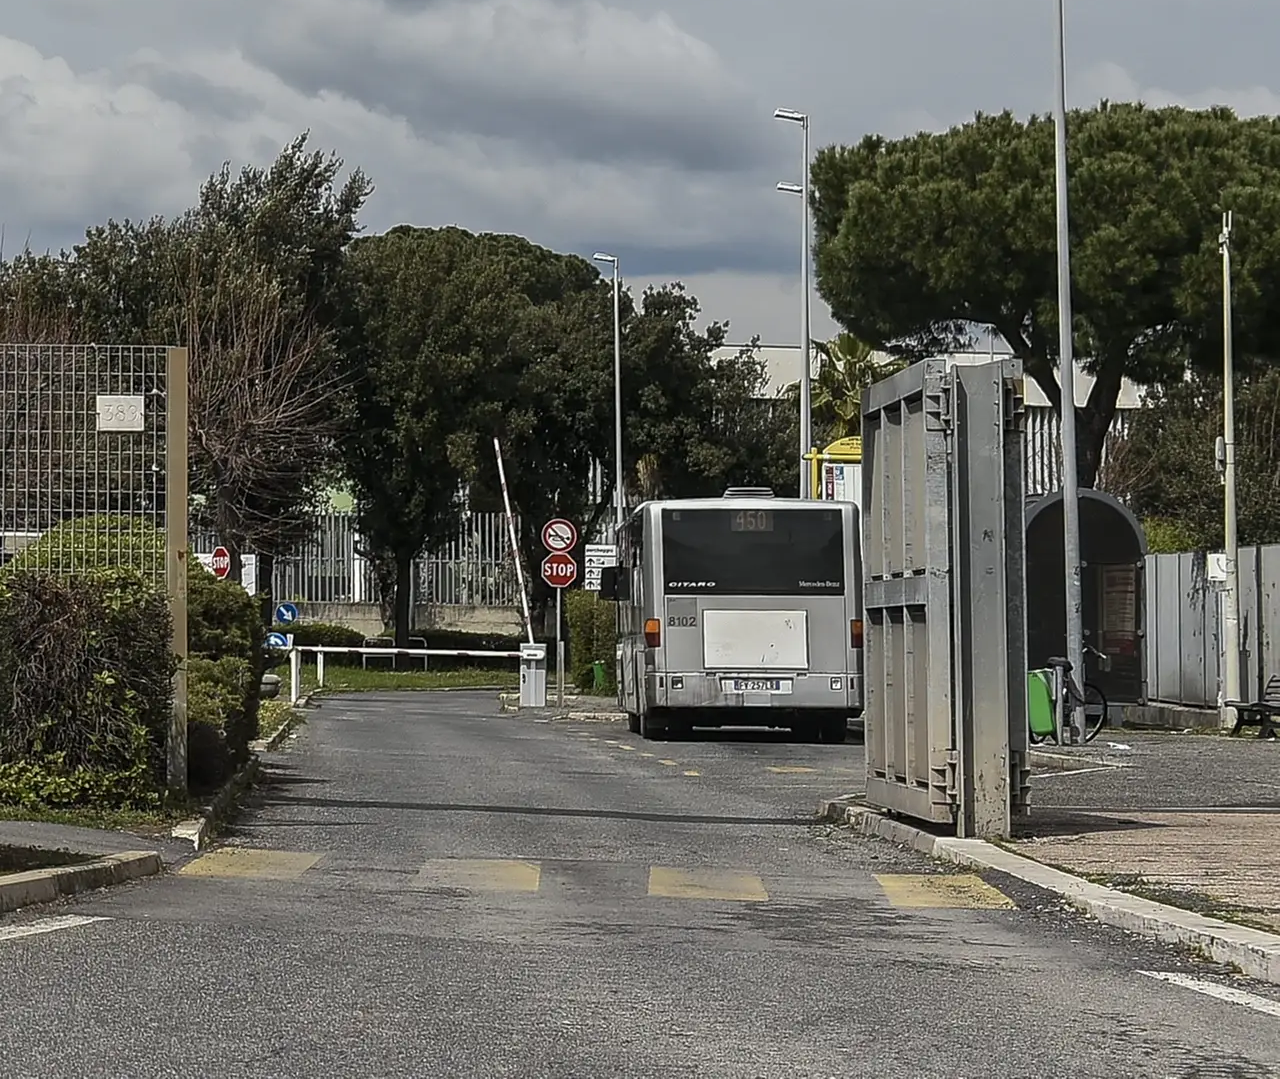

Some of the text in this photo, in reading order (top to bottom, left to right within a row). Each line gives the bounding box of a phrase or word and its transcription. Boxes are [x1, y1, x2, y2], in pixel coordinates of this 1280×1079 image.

[213, 556, 229, 569] STOP
[544, 563, 574, 576] STOP
[668, 616, 697, 627] 8102
